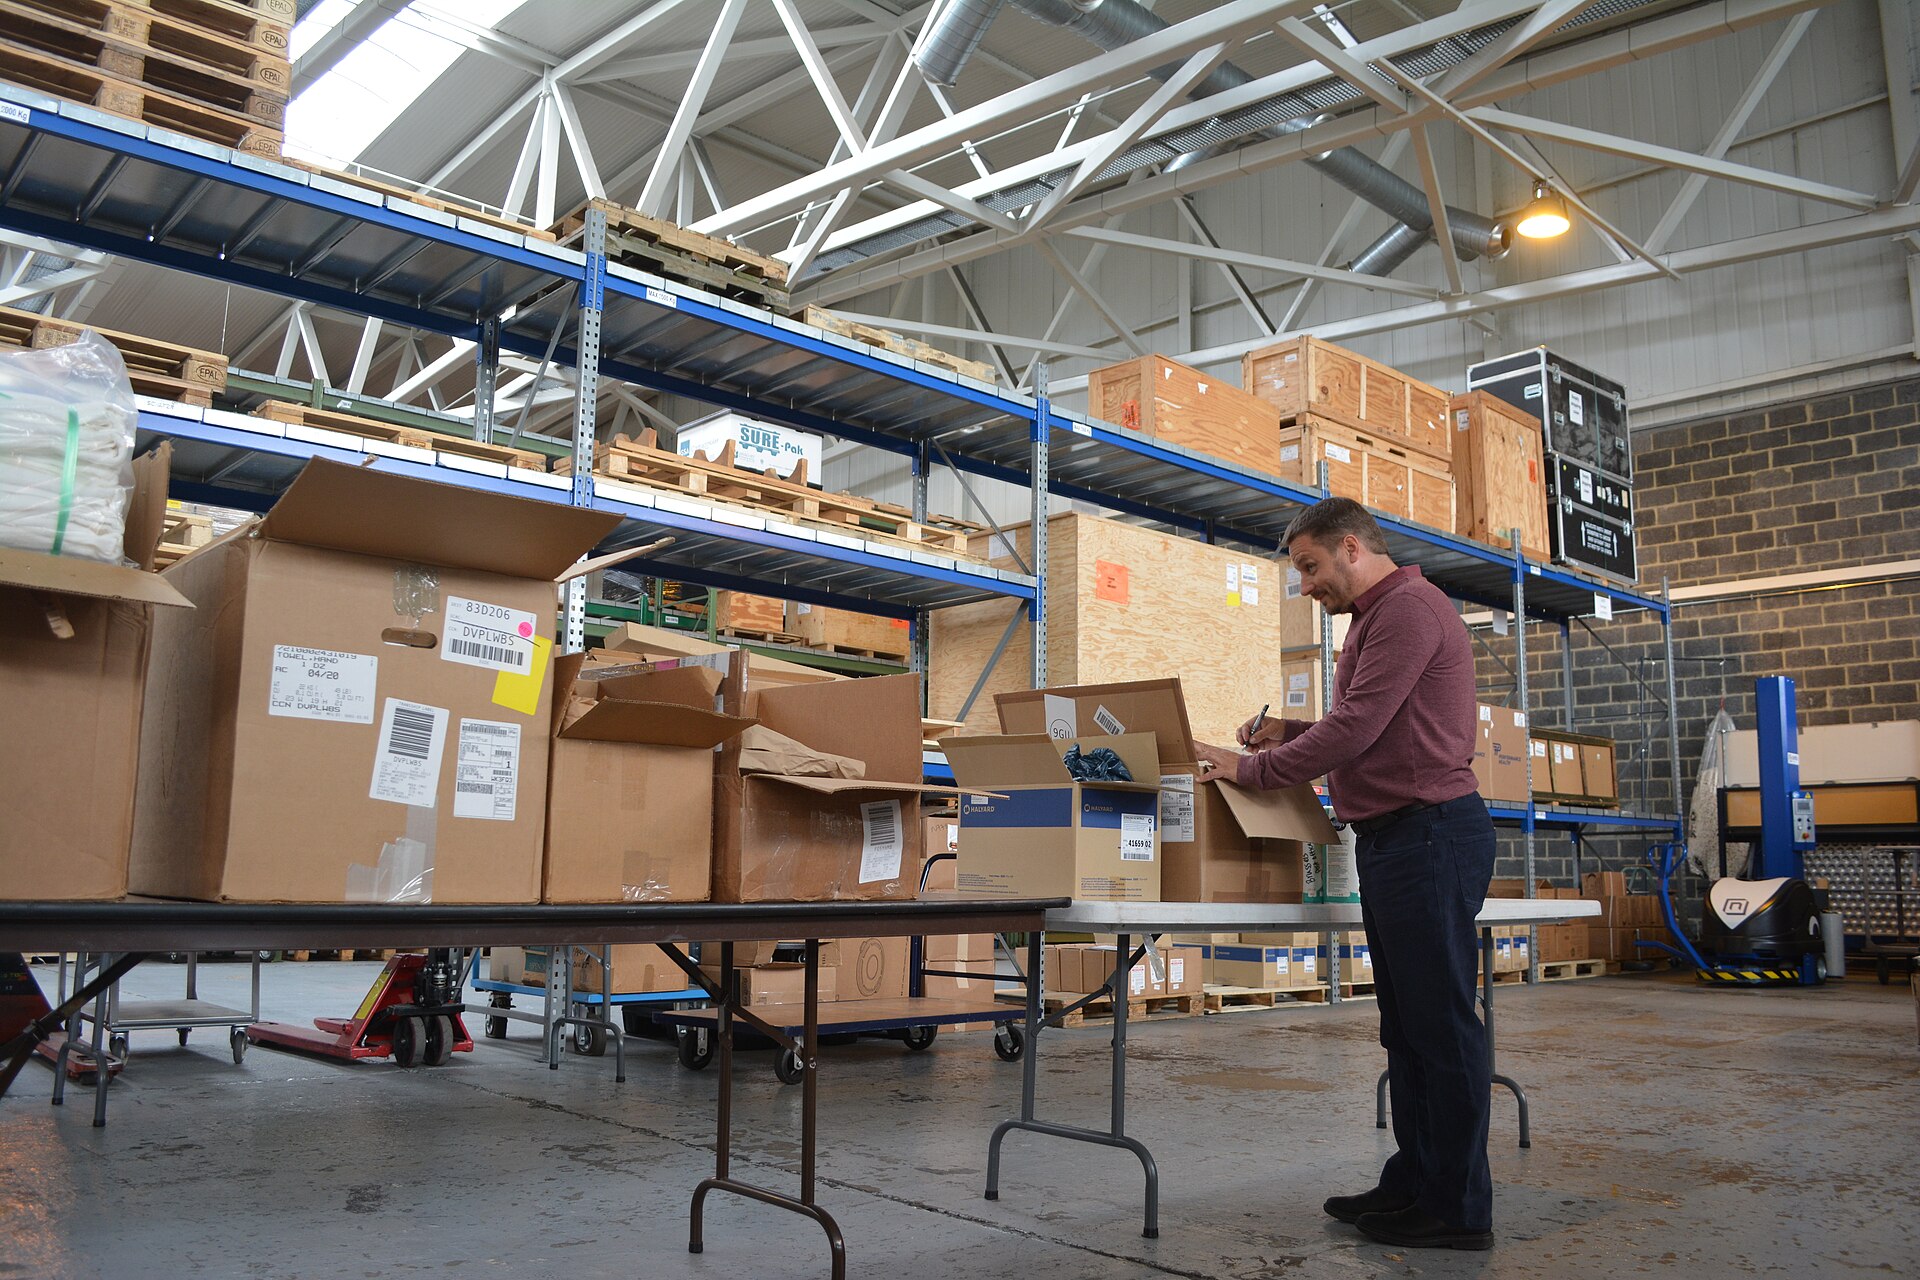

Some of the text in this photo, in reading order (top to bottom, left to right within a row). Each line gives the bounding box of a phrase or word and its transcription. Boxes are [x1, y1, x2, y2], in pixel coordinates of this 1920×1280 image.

[265, 32, 285, 47] EPAL
[264, 70, 284, 83] EPAL
[199, 367, 220, 381] EPAL
[466, 601, 511, 620] 83D206
[463, 626, 515, 646] DVPLWBS
[275, 665, 289, 673] AC
[313, 662, 326, 670] DZ
[308, 668, 340, 680] 04/20
[272, 700, 341, 713] CCN DVPLWBS
[393, 755, 423, 767] DVPLWBS
[971, 805, 996, 813] HALYARD
[1128, 839, 1152, 848] 41659 02
